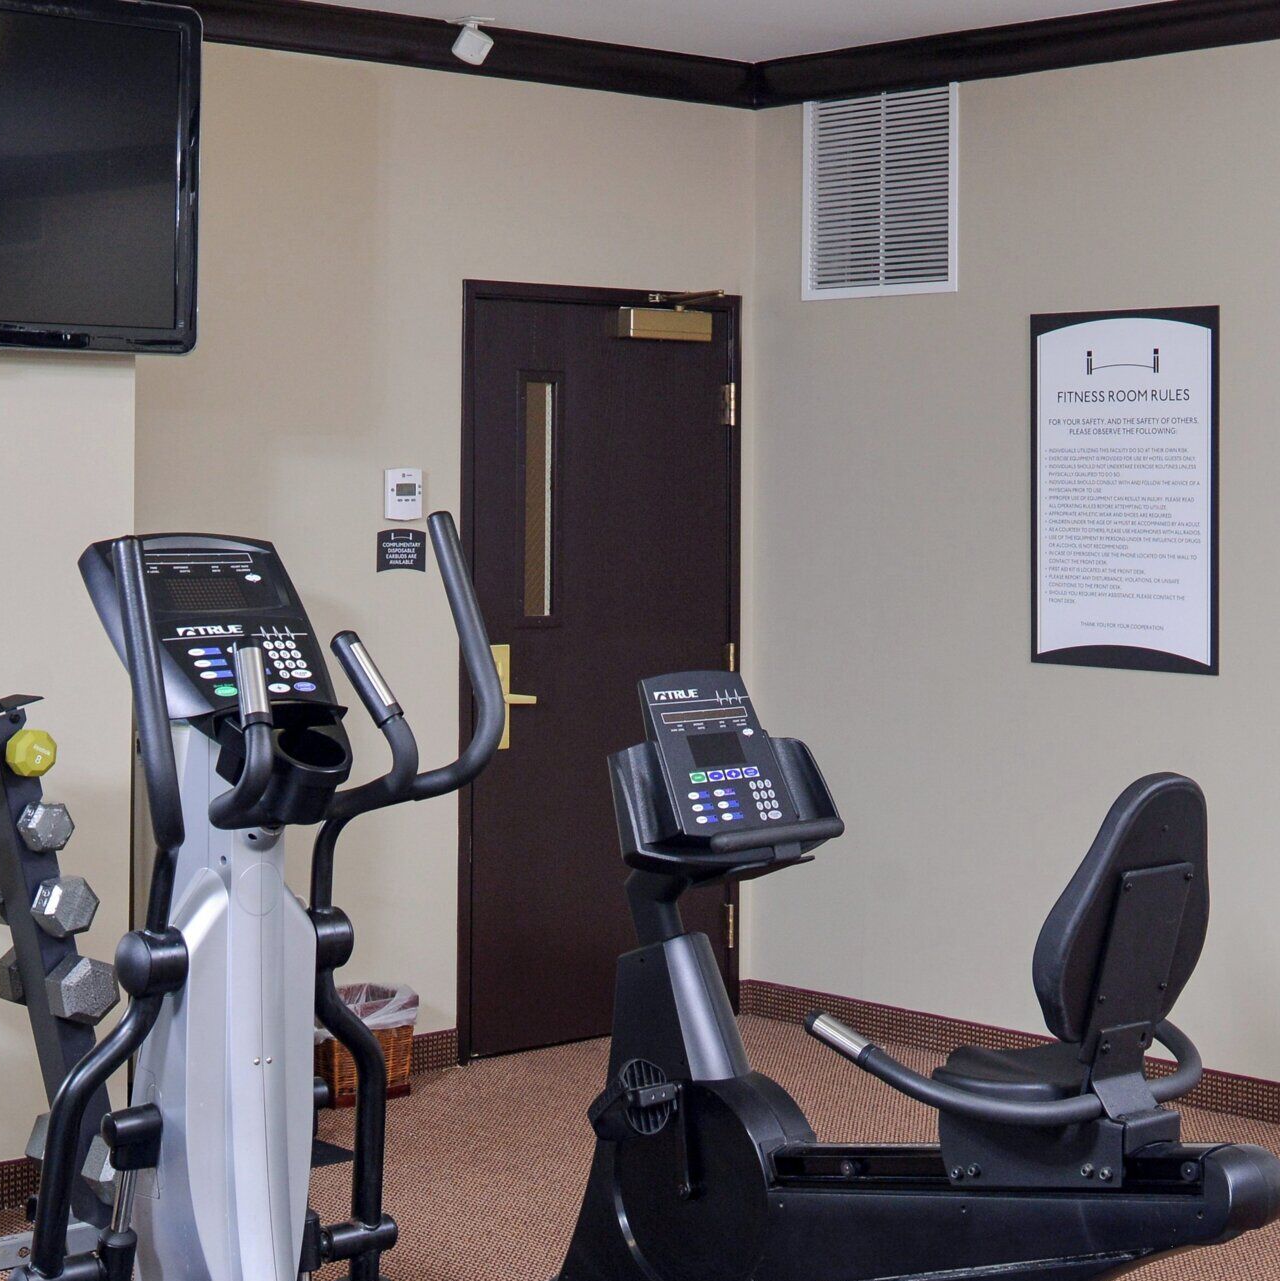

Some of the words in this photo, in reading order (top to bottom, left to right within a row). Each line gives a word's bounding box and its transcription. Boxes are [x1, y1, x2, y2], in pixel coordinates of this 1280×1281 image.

[1057, 391, 1105, 403] FITNESS
[1108, 390, 1148, 402] ROOM
[1152, 389, 1190, 402] RULES
[193, 625, 243, 635] TRUE
[669, 689, 698, 699] TRUE
[35, 755, 42, 764] 8
